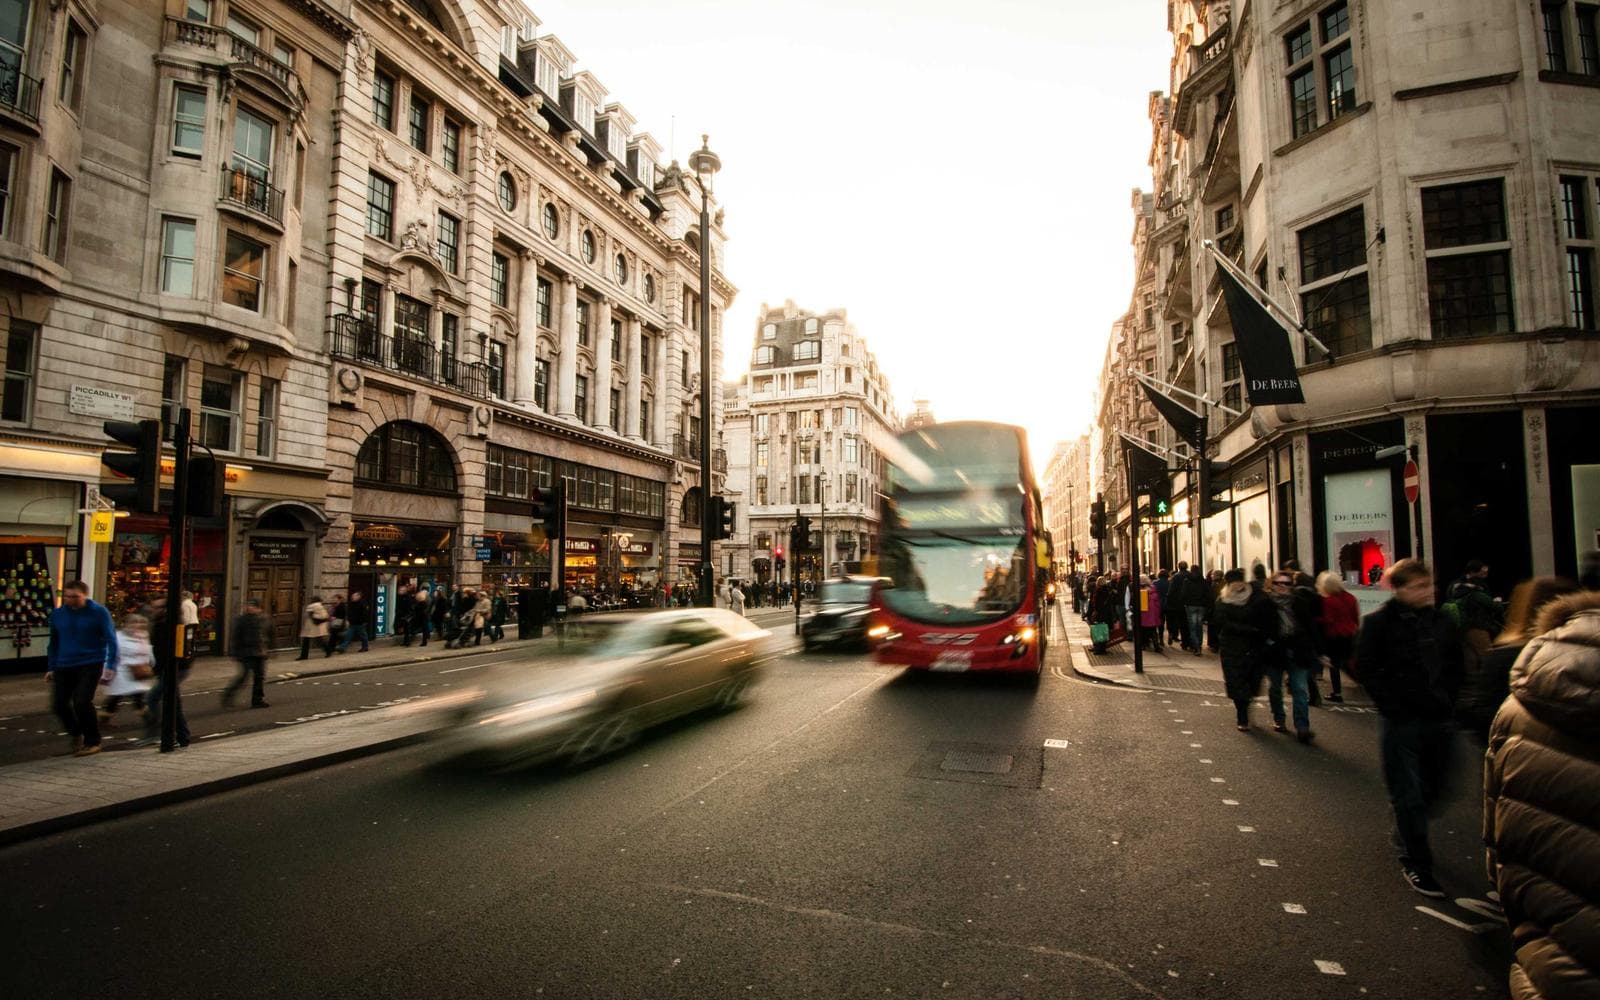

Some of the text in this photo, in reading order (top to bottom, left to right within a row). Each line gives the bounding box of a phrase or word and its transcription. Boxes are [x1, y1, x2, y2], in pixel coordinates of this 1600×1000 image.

[1252, 379, 1298, 390] DE BEERS
[75, 386, 120, 399] PICCADILLY
[1351, 512, 1388, 520] BEERS
[95, 519, 109, 532] itsu
[377, 585, 385, 633] MONEY
